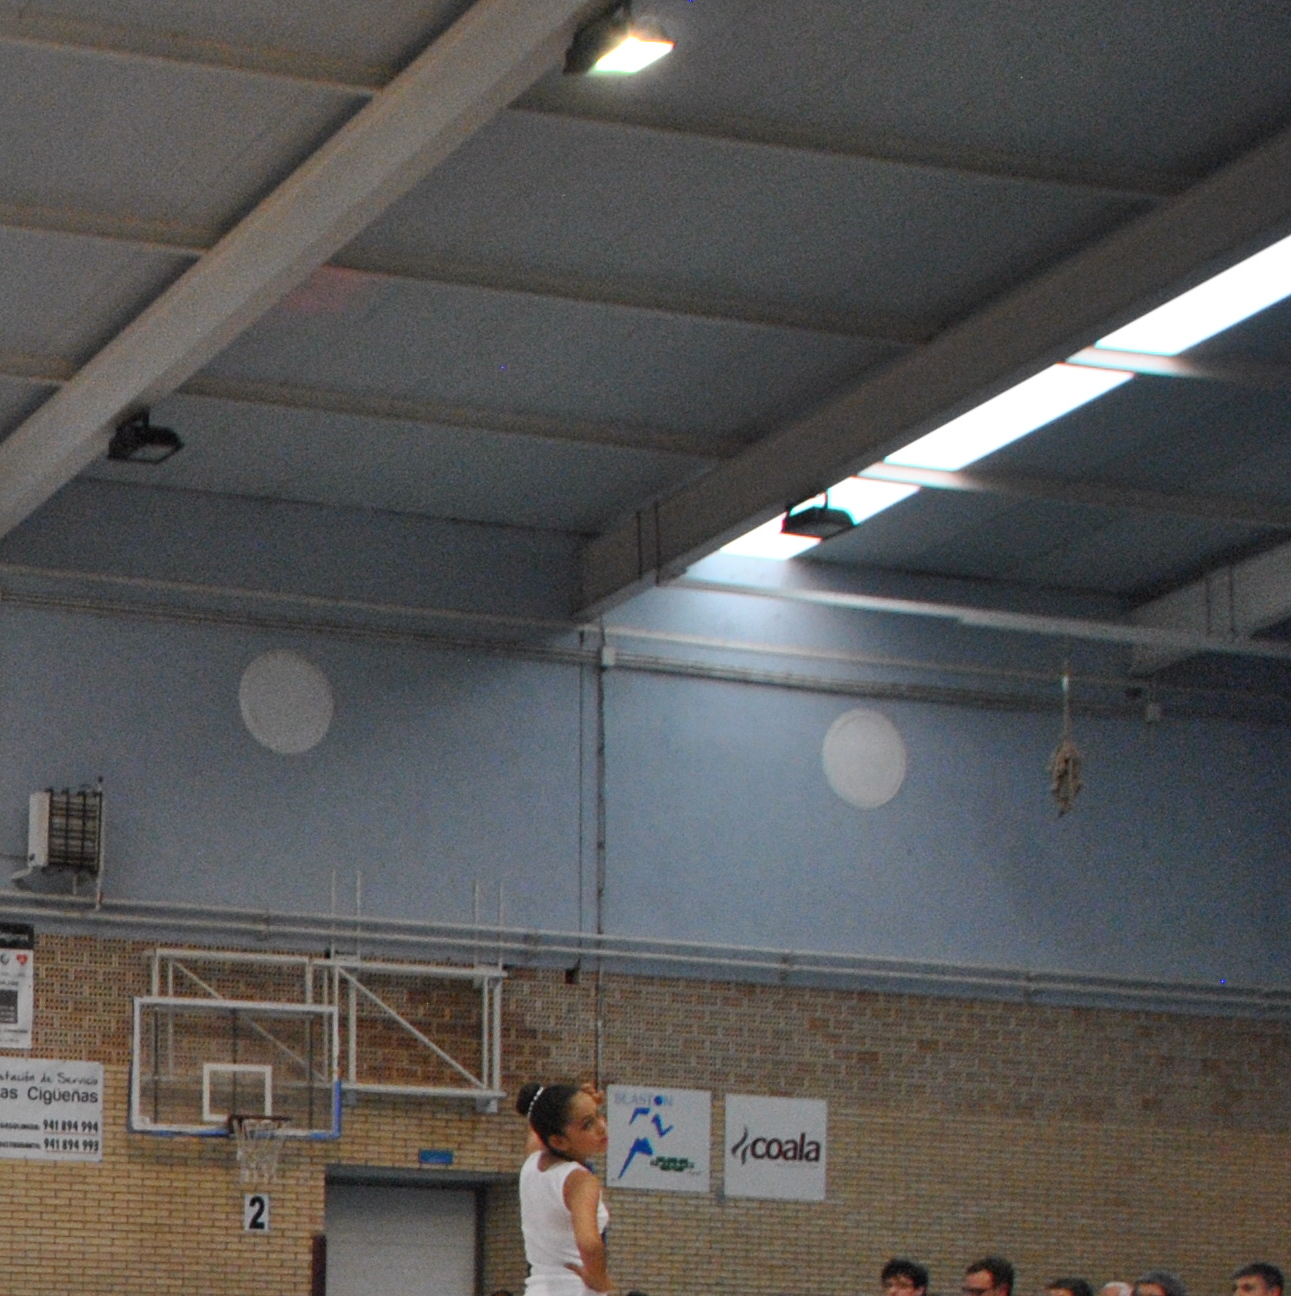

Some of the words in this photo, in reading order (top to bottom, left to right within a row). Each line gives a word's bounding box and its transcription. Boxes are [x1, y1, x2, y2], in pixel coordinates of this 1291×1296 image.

[40, 1071, 52, 1083] de
[57, 1073, 98, 1086] Servicio
[27, 1086, 98, 1105] Cigüeñas
[43, 1119, 59, 1131] 941
[44, 1138, 60, 1150] 941
[750, 1132, 821, 1162] coala
[249, 1195, 265, 1229] 2
